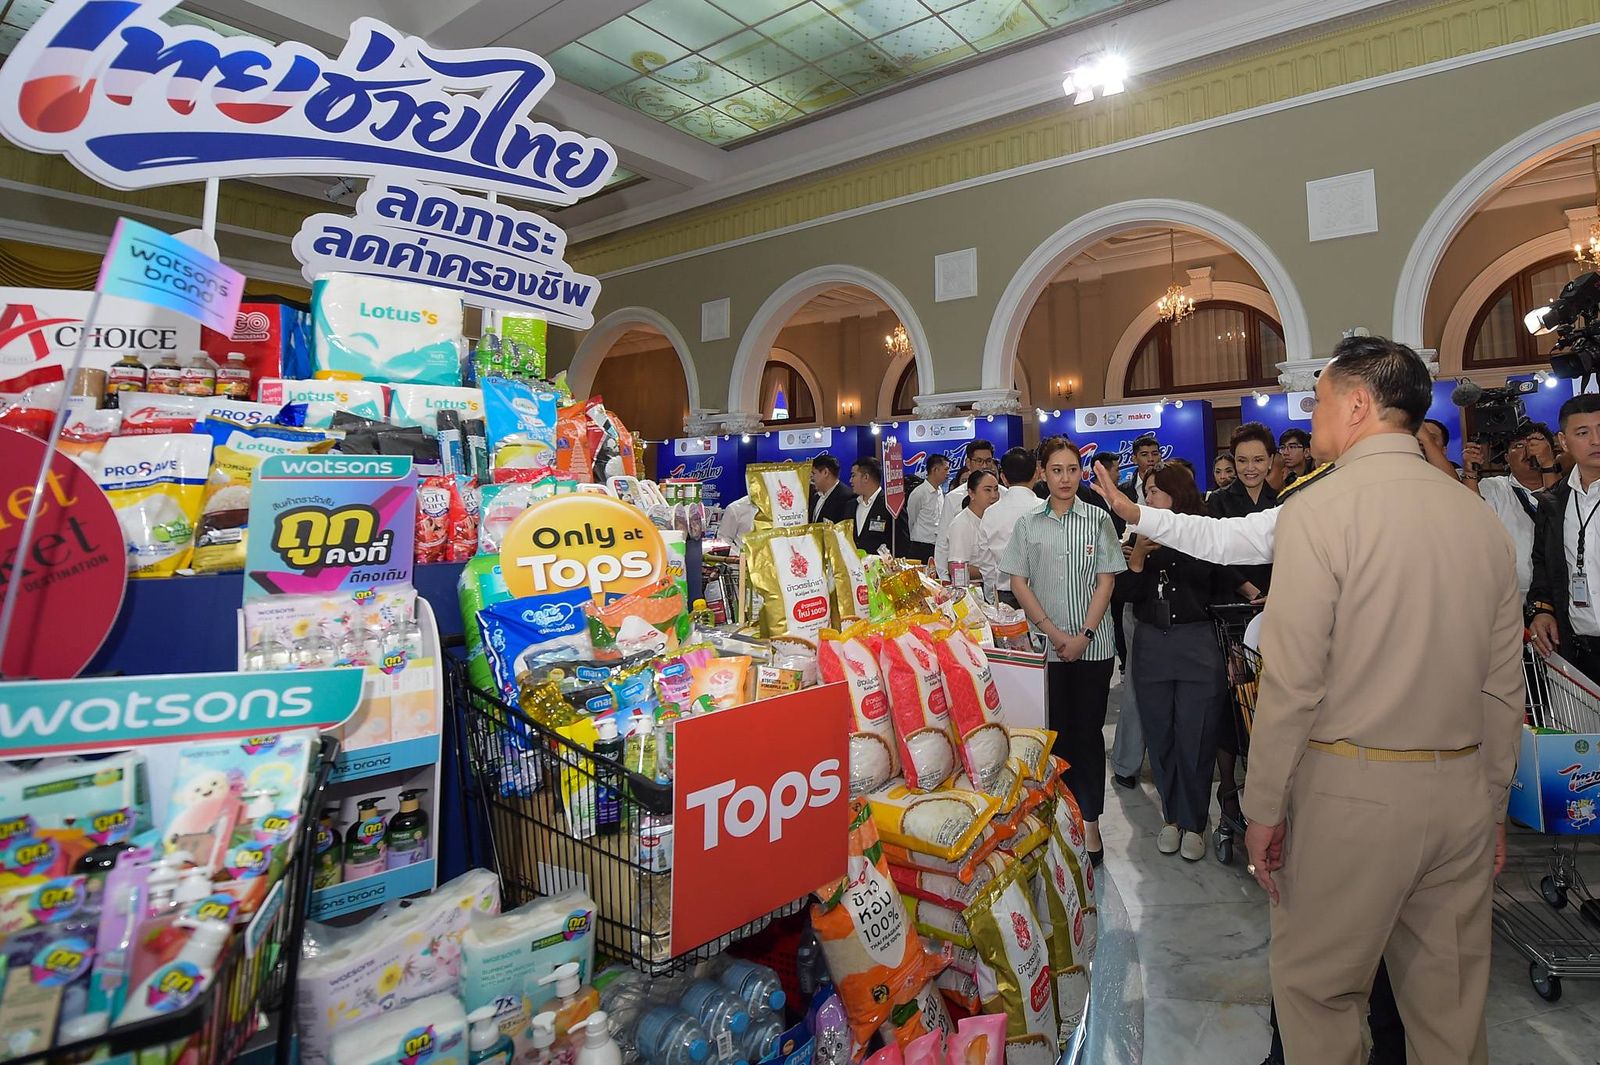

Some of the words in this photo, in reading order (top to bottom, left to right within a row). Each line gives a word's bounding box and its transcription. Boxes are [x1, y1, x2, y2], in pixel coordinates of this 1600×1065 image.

[18, 0, 609, 187] ไทยช่วยไทย
[377, 183, 557, 256] ลดภาระ
[131, 244, 229, 298] watsons
[313, 222, 591, 308] ลดค่าครองชีพ
[144, 262, 213, 304] brand
[360, 302, 438, 325] Lotus's
[289, 390, 349, 403] Lotus's
[425, 398, 479, 411] Lotus's
[210, 408, 276, 425] PROSA
[1128, 413, 1151, 421] makro
[104, 460, 177, 477] PROSAVE
[281, 460, 393, 474] watsons
[278, 509, 374, 566] ถูก
[325, 533, 390, 565] คงที่
[532, 523, 615, 549] Only
[623, 528, 643, 540] at
[348, 567, 408, 584] ดีคงเดิม
[516, 551, 653, 594] Tops
[0, 686, 313, 738] watsons
[353, 756, 391, 771] brand
[686, 758, 842, 851] Tops
[348, 886, 385, 903] brand
[852, 880, 880, 907] ข้าว
[858, 891, 892, 925] หอม
[863, 907, 899, 943] 100%
